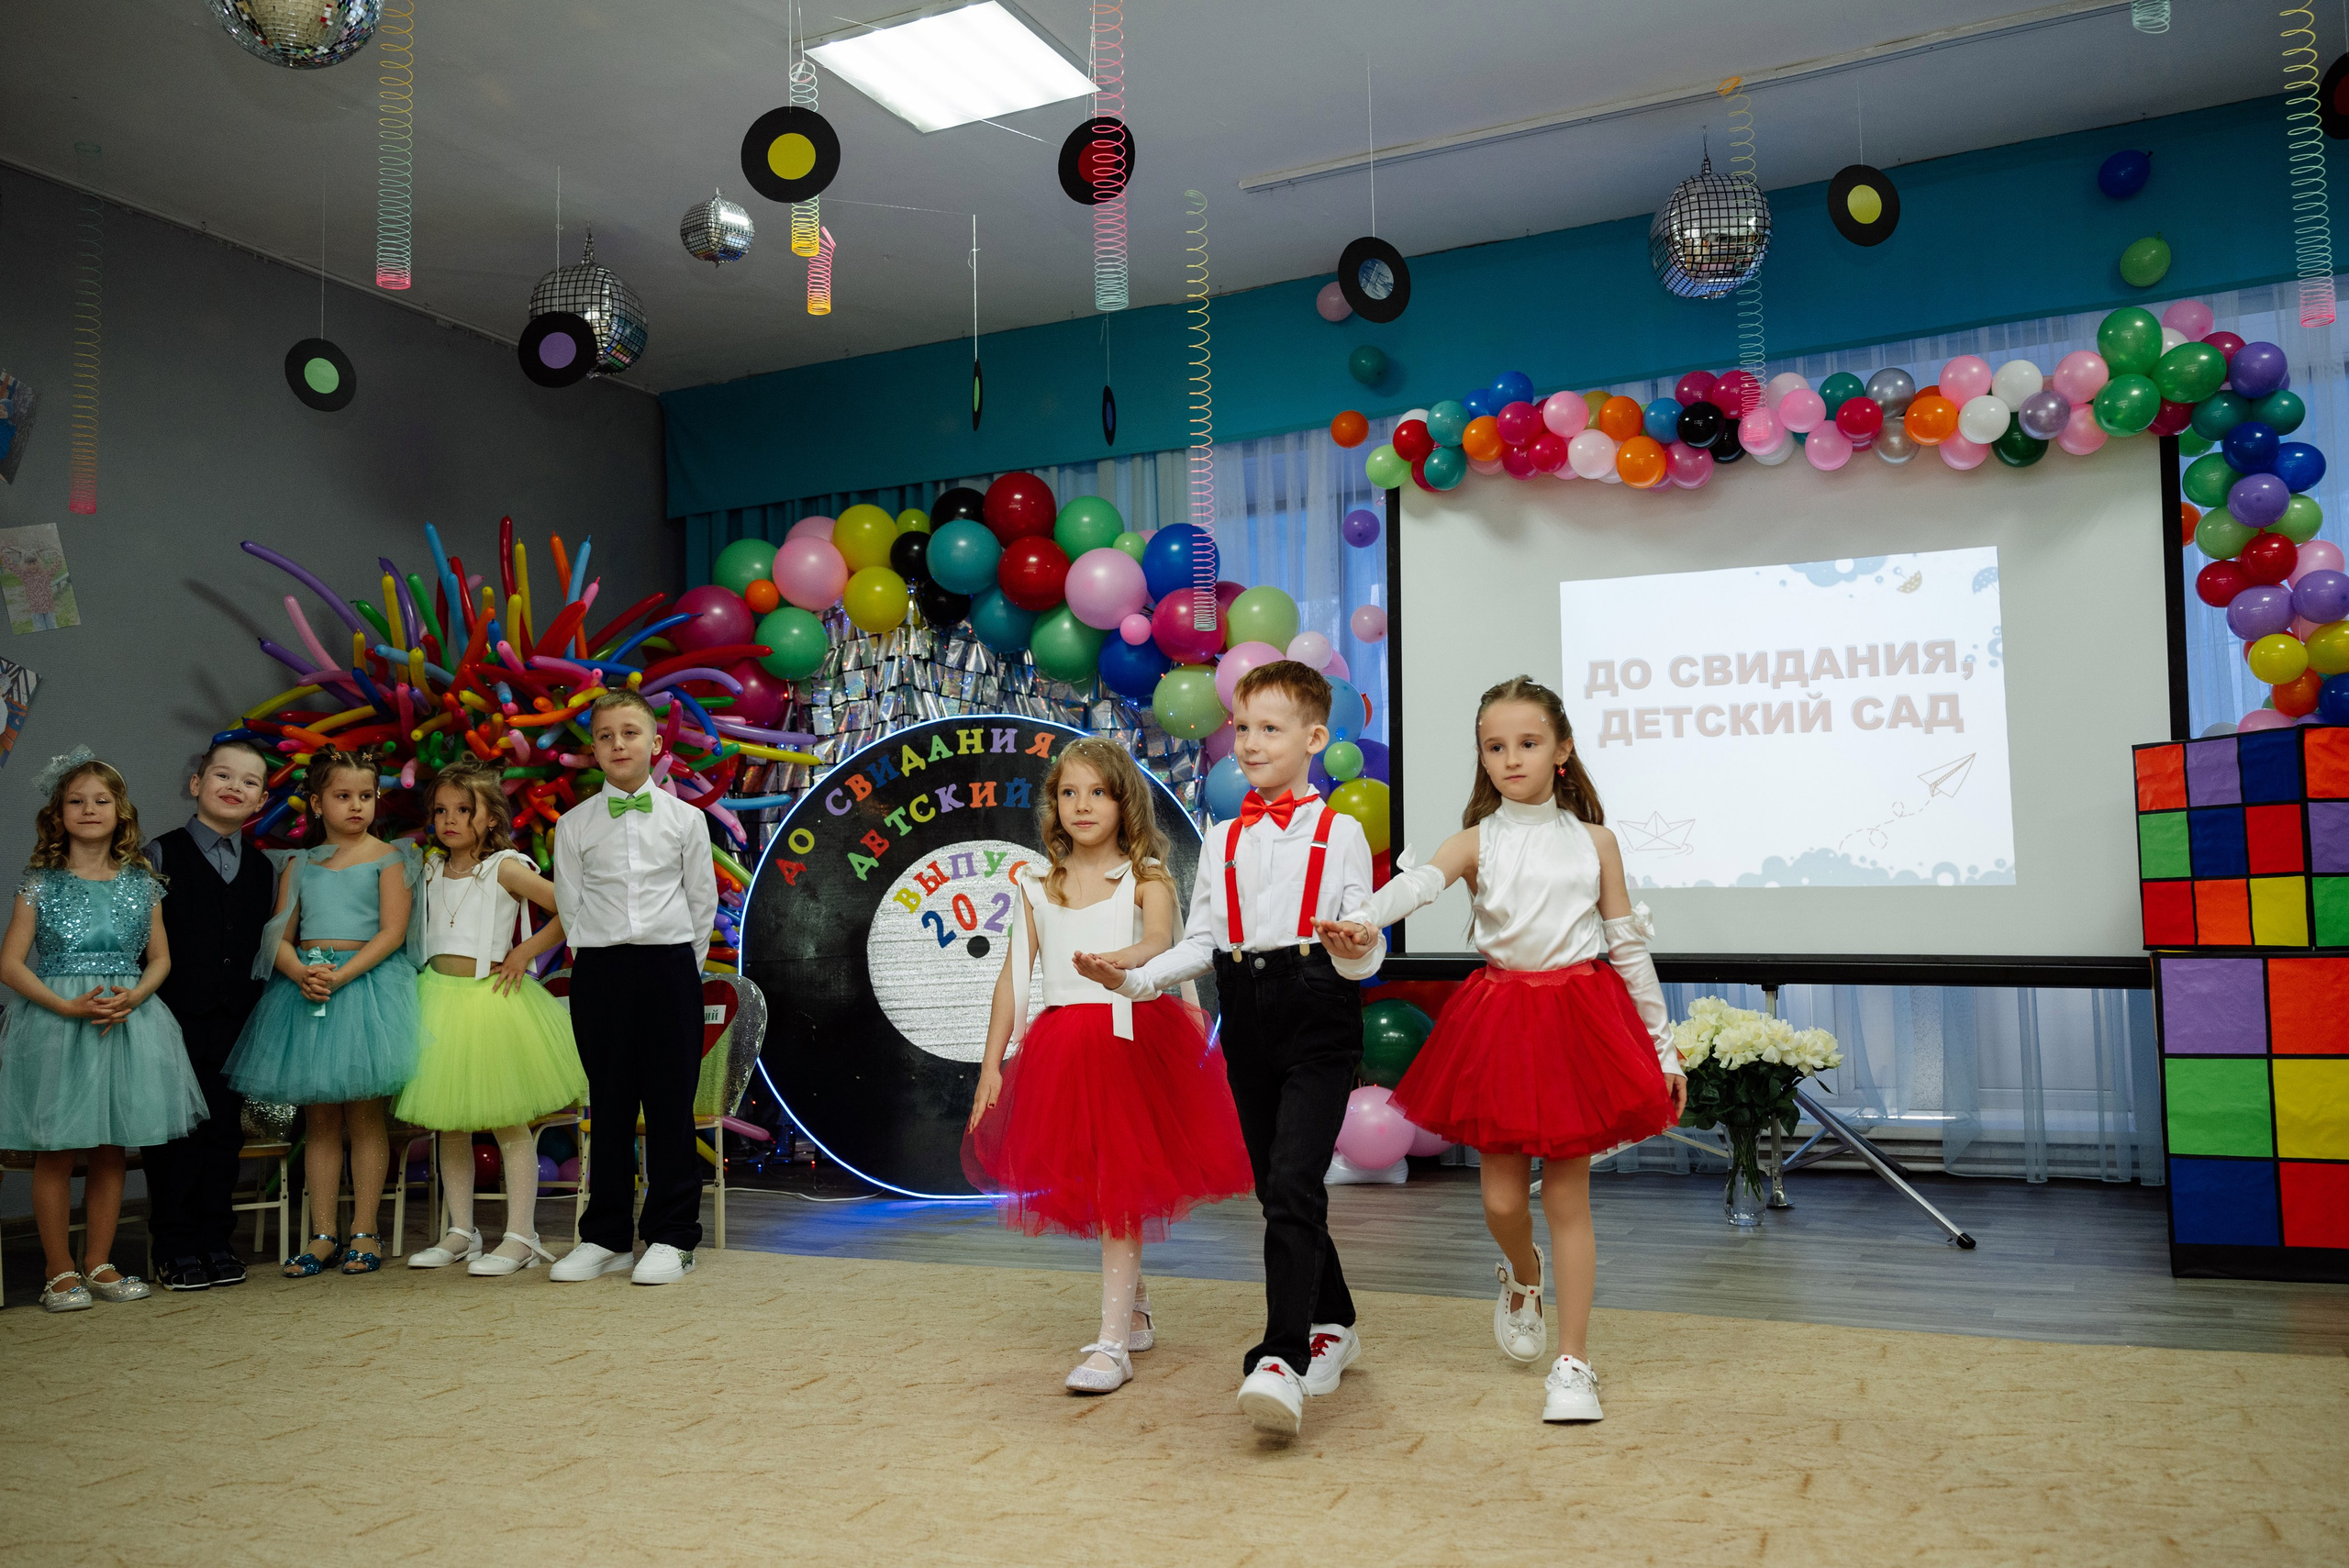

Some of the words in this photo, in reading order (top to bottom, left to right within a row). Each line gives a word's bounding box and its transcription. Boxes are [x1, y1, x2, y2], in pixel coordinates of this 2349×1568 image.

[1584, 658, 1653, 699] ДО
[1668, 638, 1975, 690] СВИДАНИЯ,
[1598, 690, 1833, 749] ДЕТСКИЙ
[1850, 692, 1965, 735] САД
[775, 828, 816, 886] ДО
[893, 850, 1030, 915] ВЫПУС
[921, 892, 1013, 950] 202
